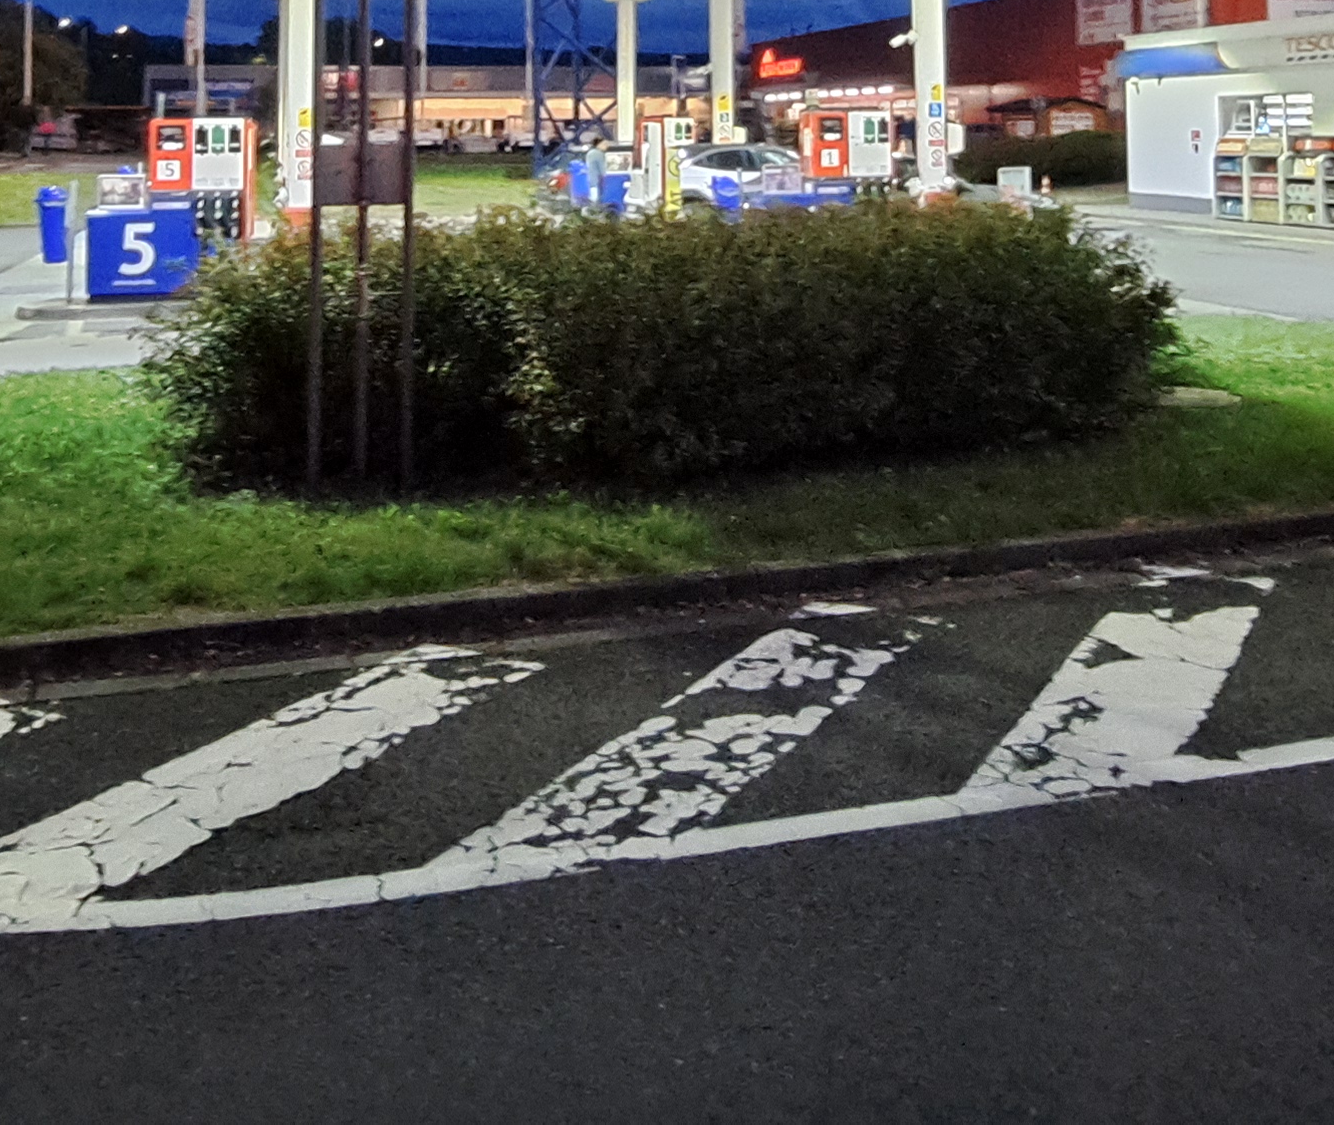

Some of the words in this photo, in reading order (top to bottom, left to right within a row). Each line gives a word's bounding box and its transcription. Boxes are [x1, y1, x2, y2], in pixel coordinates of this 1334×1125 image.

[827, 151, 834, 165] 1
[164, 162, 176, 177] 5
[117, 221, 157, 276] 5
